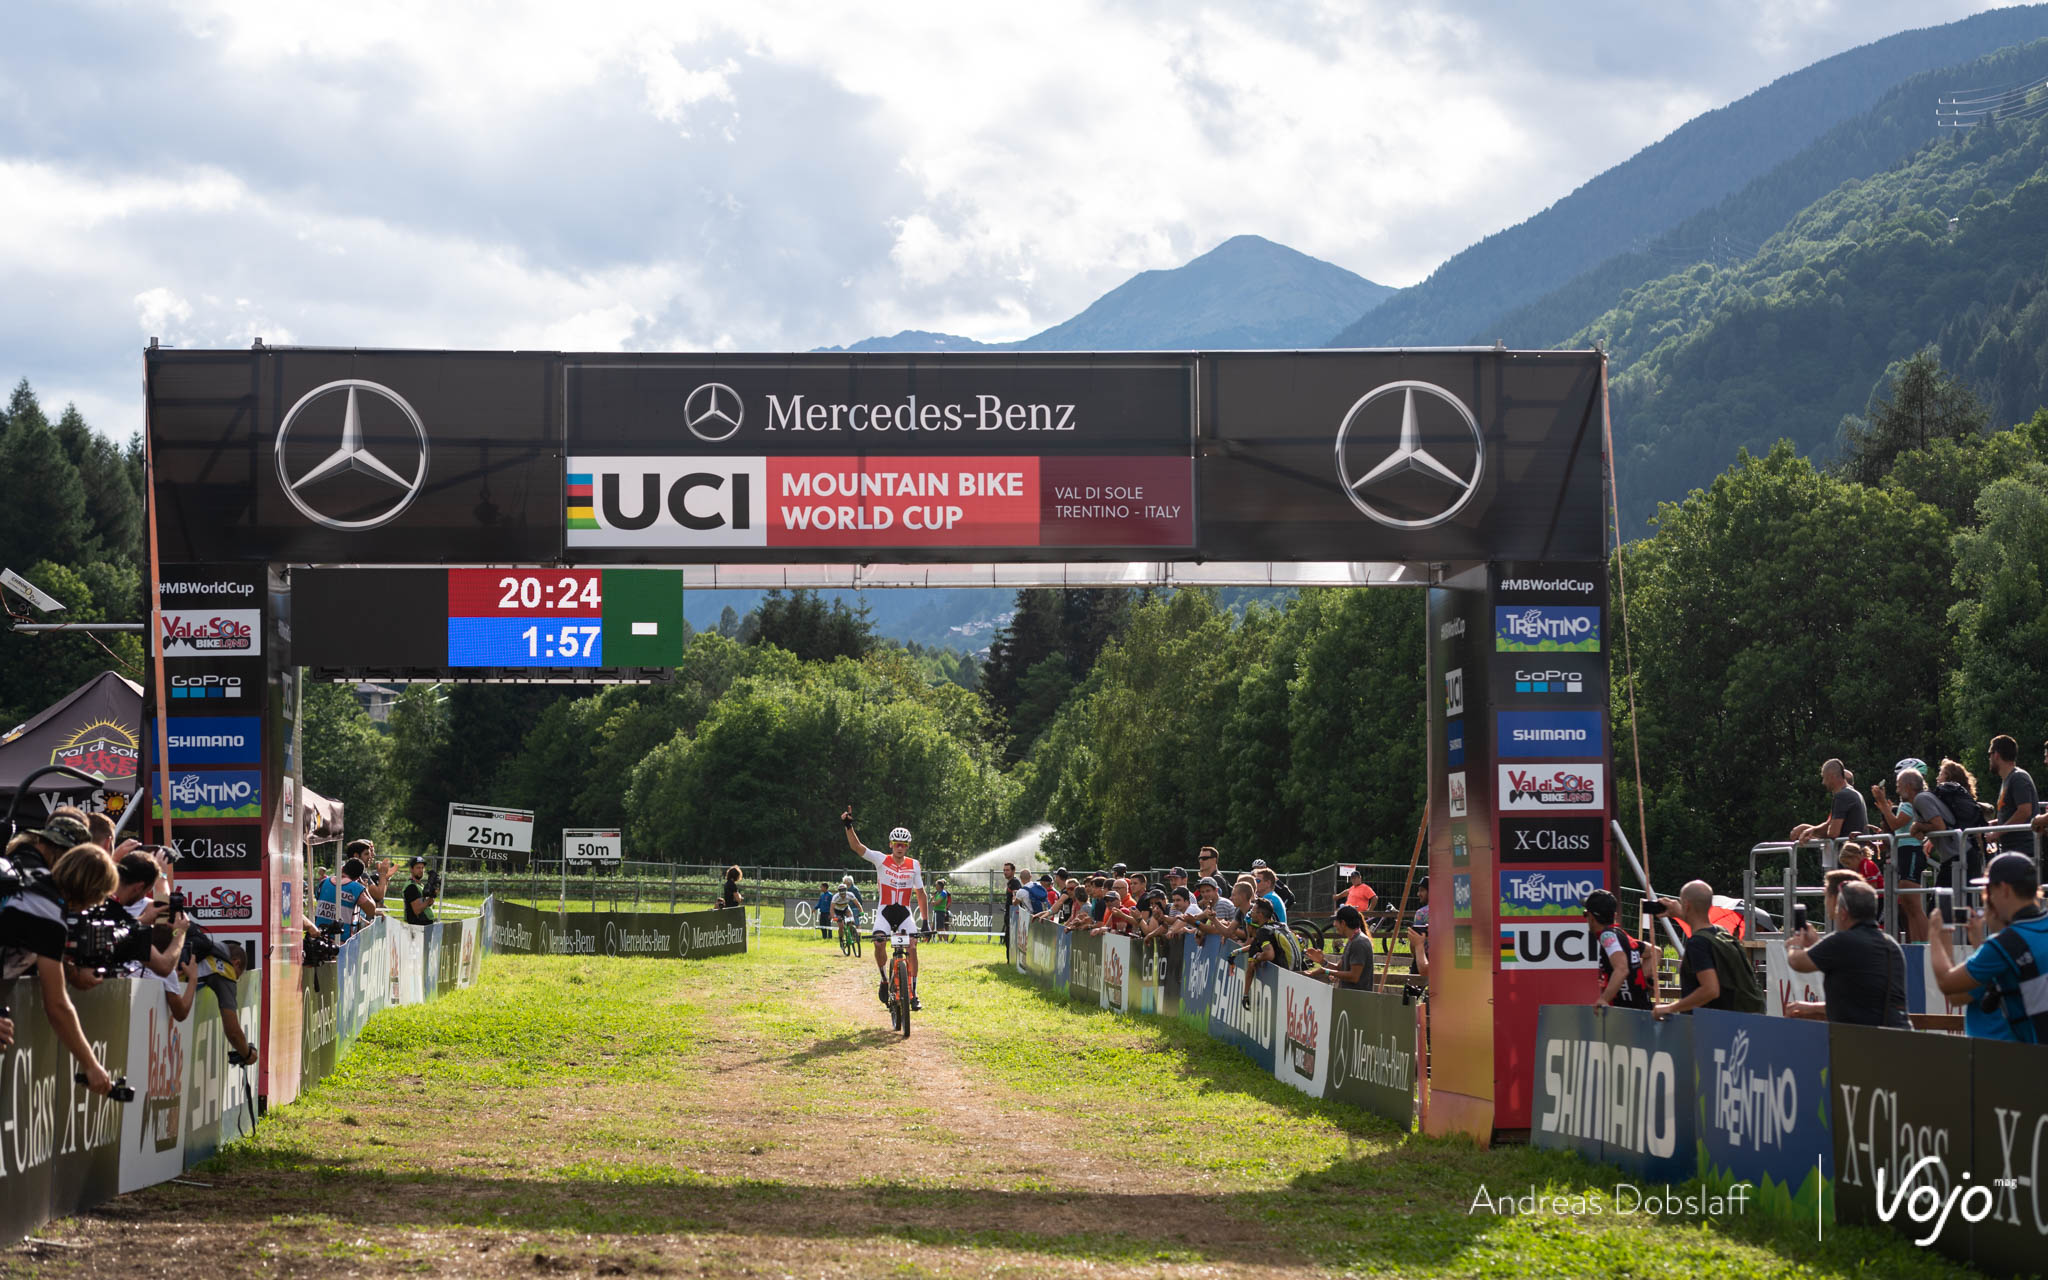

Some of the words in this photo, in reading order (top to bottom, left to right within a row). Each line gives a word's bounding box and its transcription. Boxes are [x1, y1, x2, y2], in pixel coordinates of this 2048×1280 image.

[764, 393, 1077, 431] Mercedes-Benz
[782, 472, 942, 496] MOUNTAIN
[959, 472, 1024, 496] BIKE
[1055, 486, 1082, 499] VAL
[1085, 486, 1100, 499] DI
[1104, 486, 1144, 500] SOLE
[602, 472, 750, 530] UCI
[1055, 505, 1130, 518] TRENTINO
[1145, 505, 1181, 518] ITALY
[782, 506, 893, 530] WORLD
[899, 506, 963, 530] CUP
[159, 582, 254, 597] #MBWorldCup
[498, 577, 602, 608] 20:24
[1501, 579, 1594, 594] #MBWorldCup
[161, 616, 192, 640] Val
[193, 624, 208, 637] di
[209, 617, 251, 639] Sole
[1506, 614, 1591, 638] TRENTINO
[522, 626, 601, 657] 1:57
[171, 675, 242, 686] GoPro
[1515, 670, 1583, 681] GoPro
[168, 735, 245, 748] SHIMANO
[1513, 729, 1587, 741] SHIMANO
[58, 745, 84, 758] val
[89, 741, 104, 752] di
[169, 779, 251, 804] TRENTINO
[1507, 770, 1537, 793] Val
[1539, 779, 1553, 792] di
[1553, 771, 1594, 792] Sole
[467, 826, 514, 846] 25m
[1514, 829, 1590, 850] X-Class
[171, 838, 246, 859] X-Class
[470, 847, 508, 860] X-Class
[577, 843, 609, 856] 50m
[194, 894, 208, 907] di
[210, 886, 252, 907] Sole
[341, 892, 355, 901] UC
[1509, 878, 1594, 902] TRENTINO
[319, 901, 337, 912] VIDE
[619, 929, 670, 952] Mercedes-Benz
[692, 924, 743, 950] Mercedes-Benz
[1519, 929, 1598, 963] UCI
[1350, 1028, 1410, 1092] Mercedes-Benz
[1541, 1039, 1676, 1159] SHIMANO
[1714, 1048, 1797, 1151] TRENTINO
[1840, 1083, 1950, 1207] X-Class
